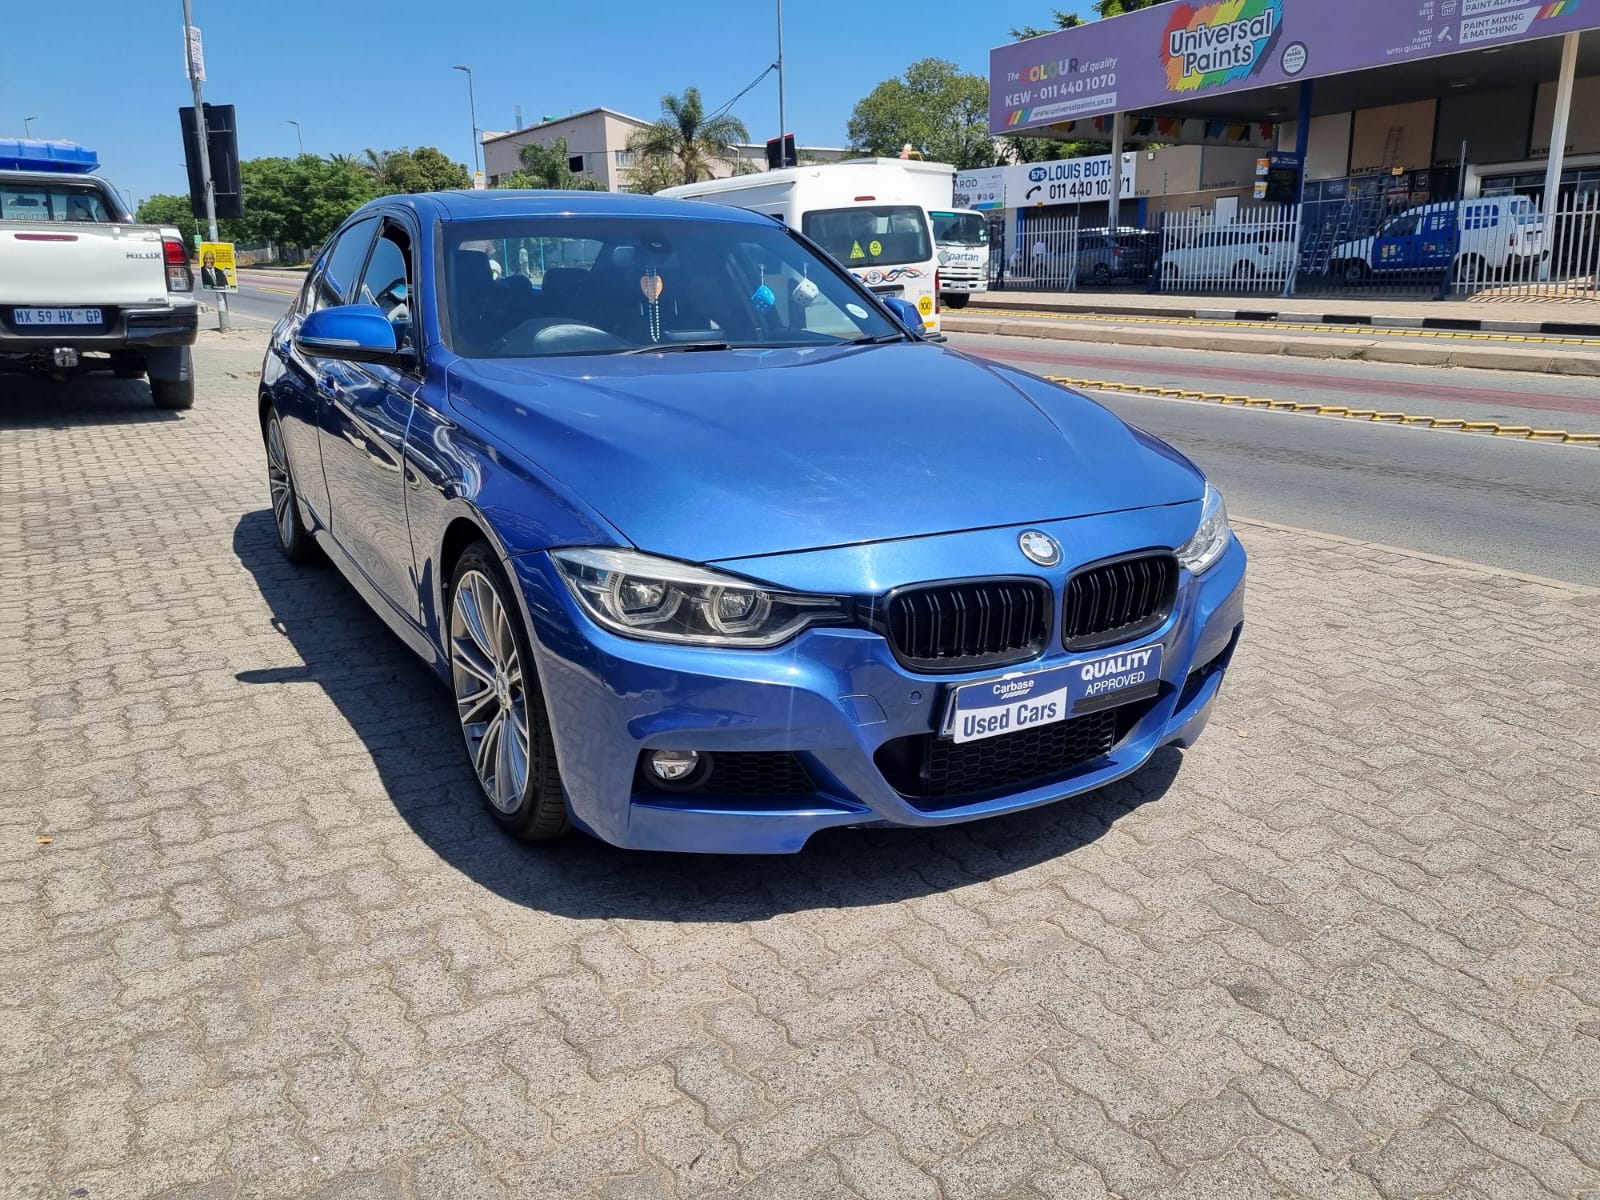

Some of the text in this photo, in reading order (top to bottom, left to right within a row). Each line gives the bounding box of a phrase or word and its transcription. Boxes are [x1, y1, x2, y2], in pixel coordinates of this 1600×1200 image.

[1465, 1, 1491, 12] PAINT
[1171, 11, 1272, 55] Universal
[1418, 28, 1433, 36] YOU
[1463, 13, 1524, 31] PAINT MIXING
[1470, 23, 1518, 38] MATCHING
[1185, 43, 1251, 74] Paints
[1403, 42, 1432, 53] QUALITY
[1007, 57, 1117, 83] The COLOUR of quality
[1005, 90, 1031, 107] KEW
[1040, 85, 1057, 99] 011
[1060, 79, 1083, 95] 440
[1086, 73, 1116, 90] 1070
[1048, 163, 1080, 181] LOUIS
[1084, 159, 1122, 177] BOTH
[1049, 183, 1066, 199] 011
[1069, 181, 1092, 197] 440
[1095, 177, 1130, 195] 10/1
[16, 310, 100, 323] MX 59 HX GP
[920, 301, 931, 310] 100
[1081, 650, 1152, 681] QUALITY
[993, 679, 1035, 695] Carbase
[1085, 671, 1146, 696] APPROVED
[963, 701, 1057, 737] Used Cars
